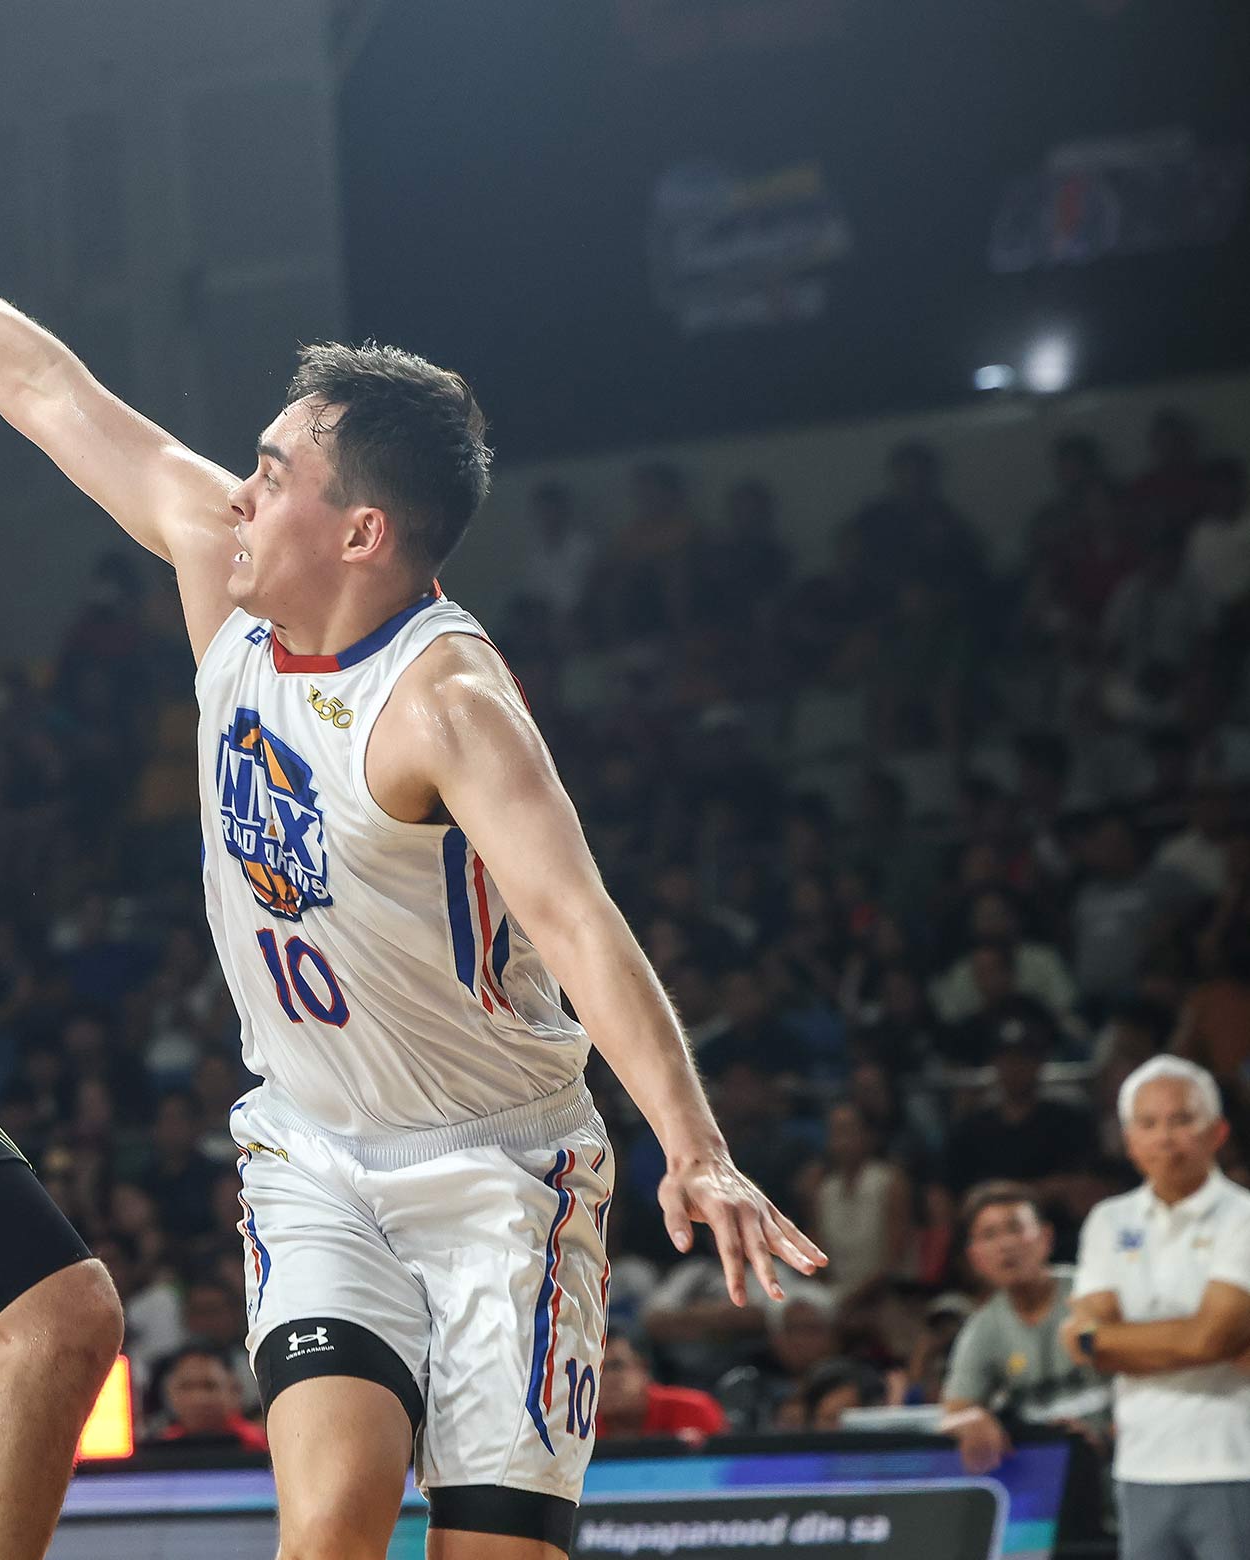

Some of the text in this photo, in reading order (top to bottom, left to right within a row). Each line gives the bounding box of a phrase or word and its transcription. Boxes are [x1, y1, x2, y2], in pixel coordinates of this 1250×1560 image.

[255, 927, 351, 1029] 10
[565, 1357, 596, 1440] 10
[848, 1514, 890, 1543] sa
